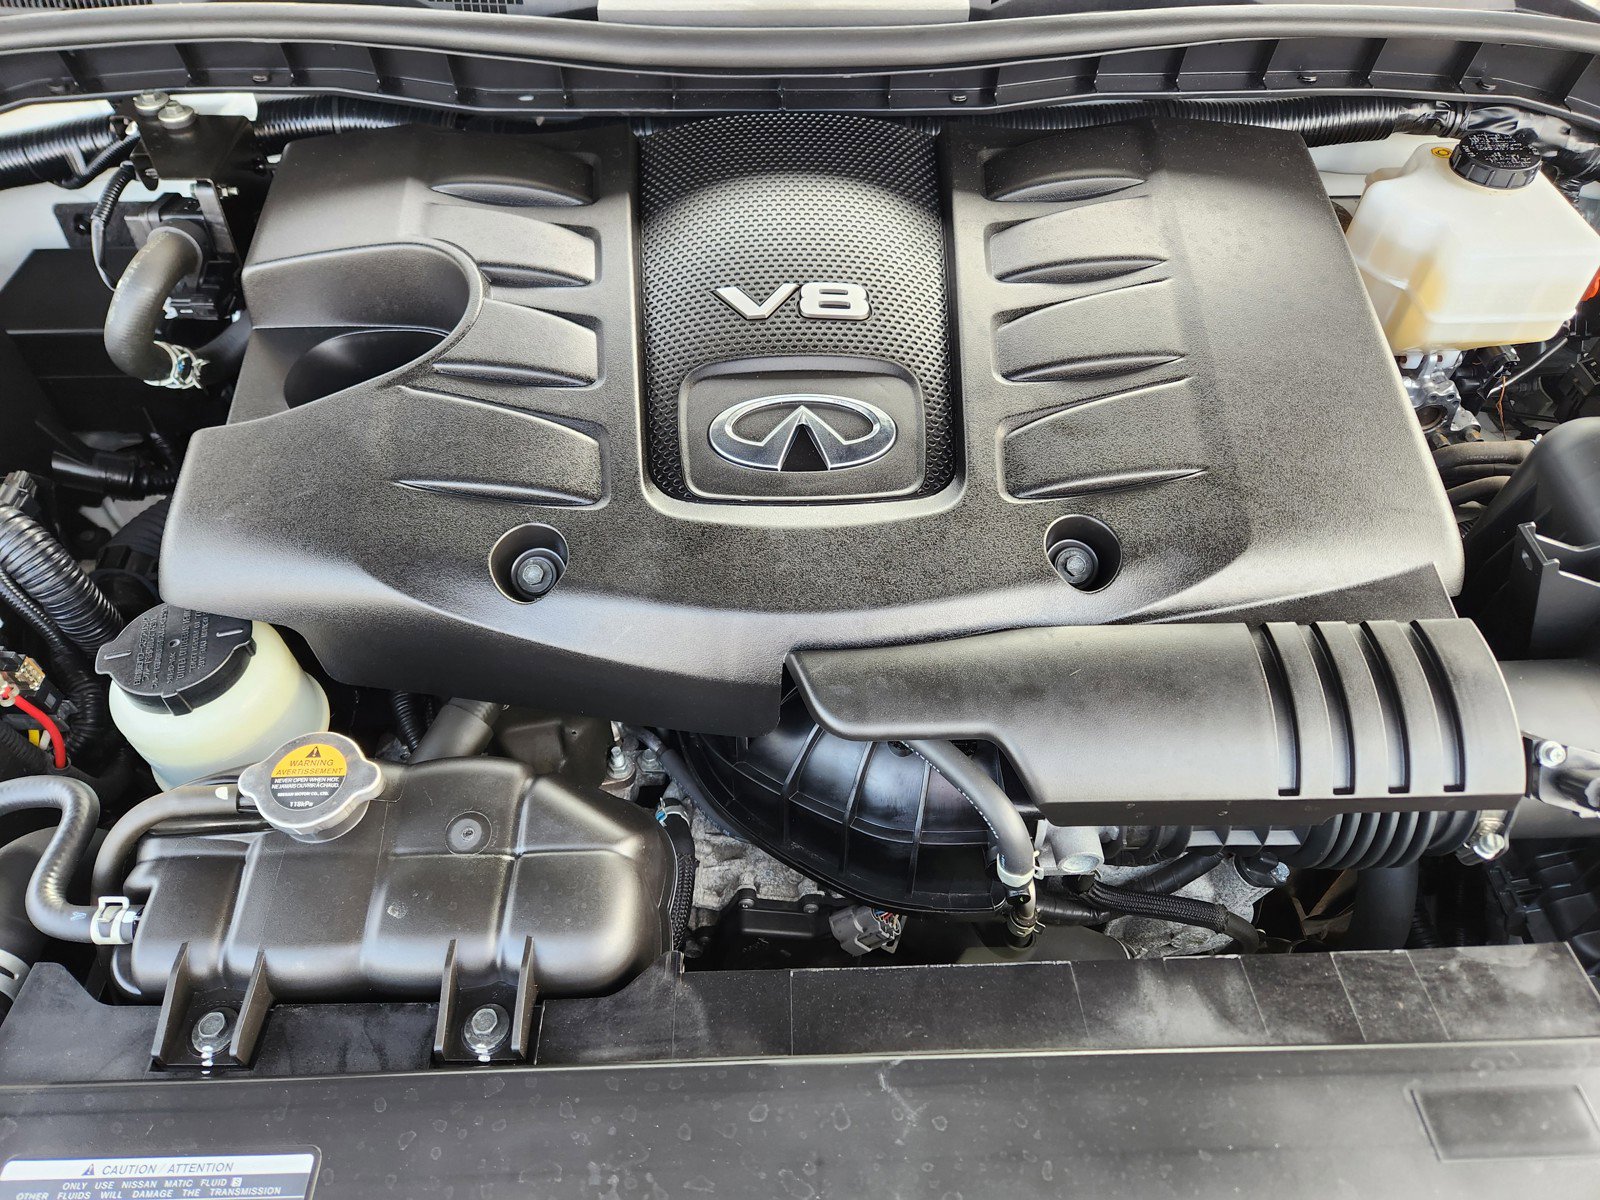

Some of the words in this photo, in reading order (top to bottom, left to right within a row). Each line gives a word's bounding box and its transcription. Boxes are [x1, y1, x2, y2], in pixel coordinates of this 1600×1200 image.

[709, 282, 872, 320] V8
[289, 759, 334, 767] WARNING
[276, 767, 343, 776] AVERTISSEMENT
[102, 1164, 157, 1175] CAUTION
[167, 1162, 234, 1173] ATTENTION
[62, 1182, 88, 1191] ONLY
[94, 1181, 115, 1190] USE
[121, 1180, 158, 1189] NISSAN
[164, 1179, 193, 1188] MATIC
[200, 1178, 227, 1187] FLUID
[15, 1192, 49, 1200] OTHER
[57, 1191, 91, 1200] FLUIDS
[100, 1191, 122, 1199] WILL
[132, 1189, 173, 1199] DAMAGE
[182, 1188, 201, 1197] THE
[210, 1187, 281, 1197] TRANSMISSION
